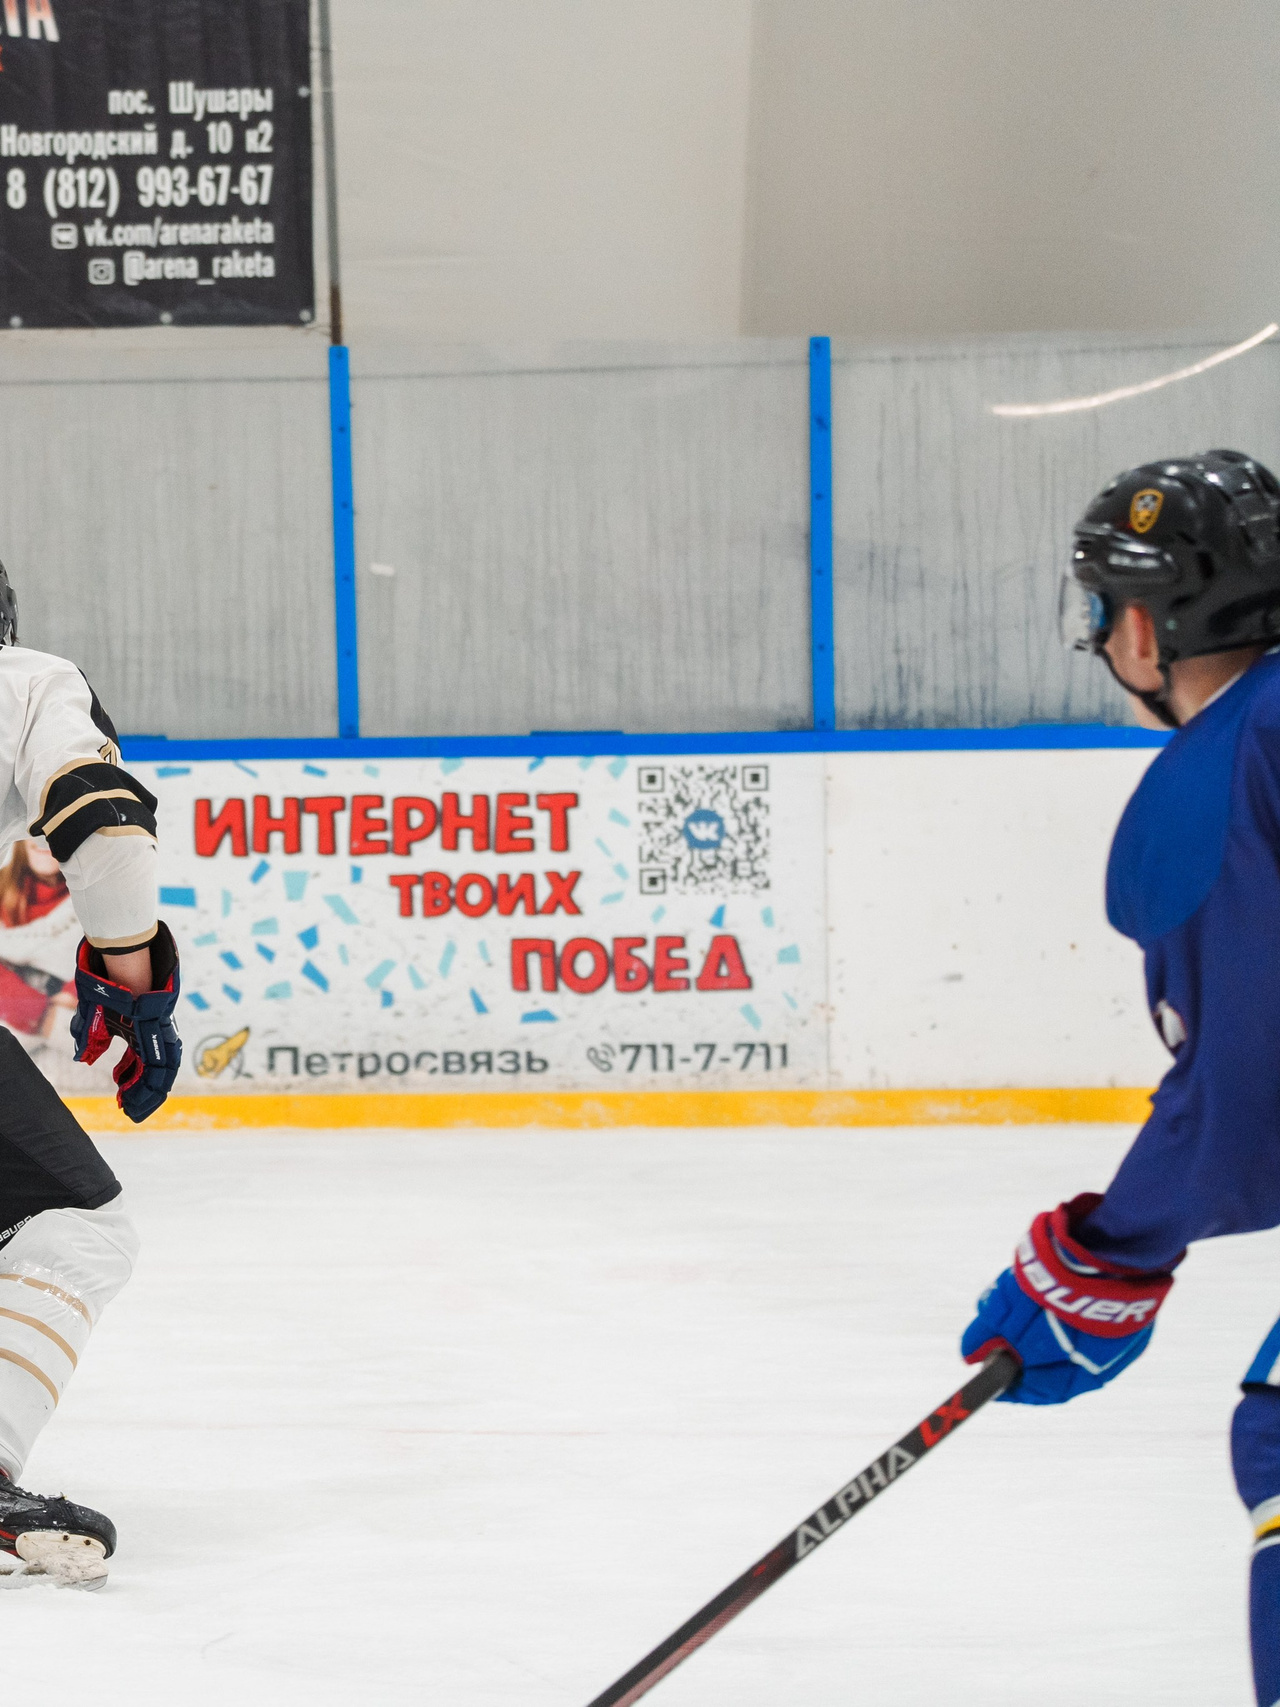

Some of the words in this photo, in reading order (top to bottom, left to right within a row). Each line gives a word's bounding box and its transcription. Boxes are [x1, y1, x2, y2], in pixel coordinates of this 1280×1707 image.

[108, 90, 155, 115] пос.
[169, 81, 273, 121] Шушары
[0, 122, 158, 165] Новгородский
[170, 130, 194, 159] д.
[207, 121, 233, 154] 10
[245, 120, 273, 153] к2
[7, 167, 27, 209] 8
[43, 167, 120, 219] (812)
[137, 165, 273, 207] 993-67-67
[83, 215, 275, 248] vk.com/arenaraketa
[123, 250, 275, 286] @arena_raketa
[193, 792, 579, 858] ИНТЕРНЕТ
[389, 870, 582, 918] ТВОИХ
[509, 934, 753, 995] ПОБЕД
[267, 1045, 549, 1079] Петросвязь
[619, 1042, 790, 1072] 711-7-711
[795, 1445, 917, 1559] ALPHA
